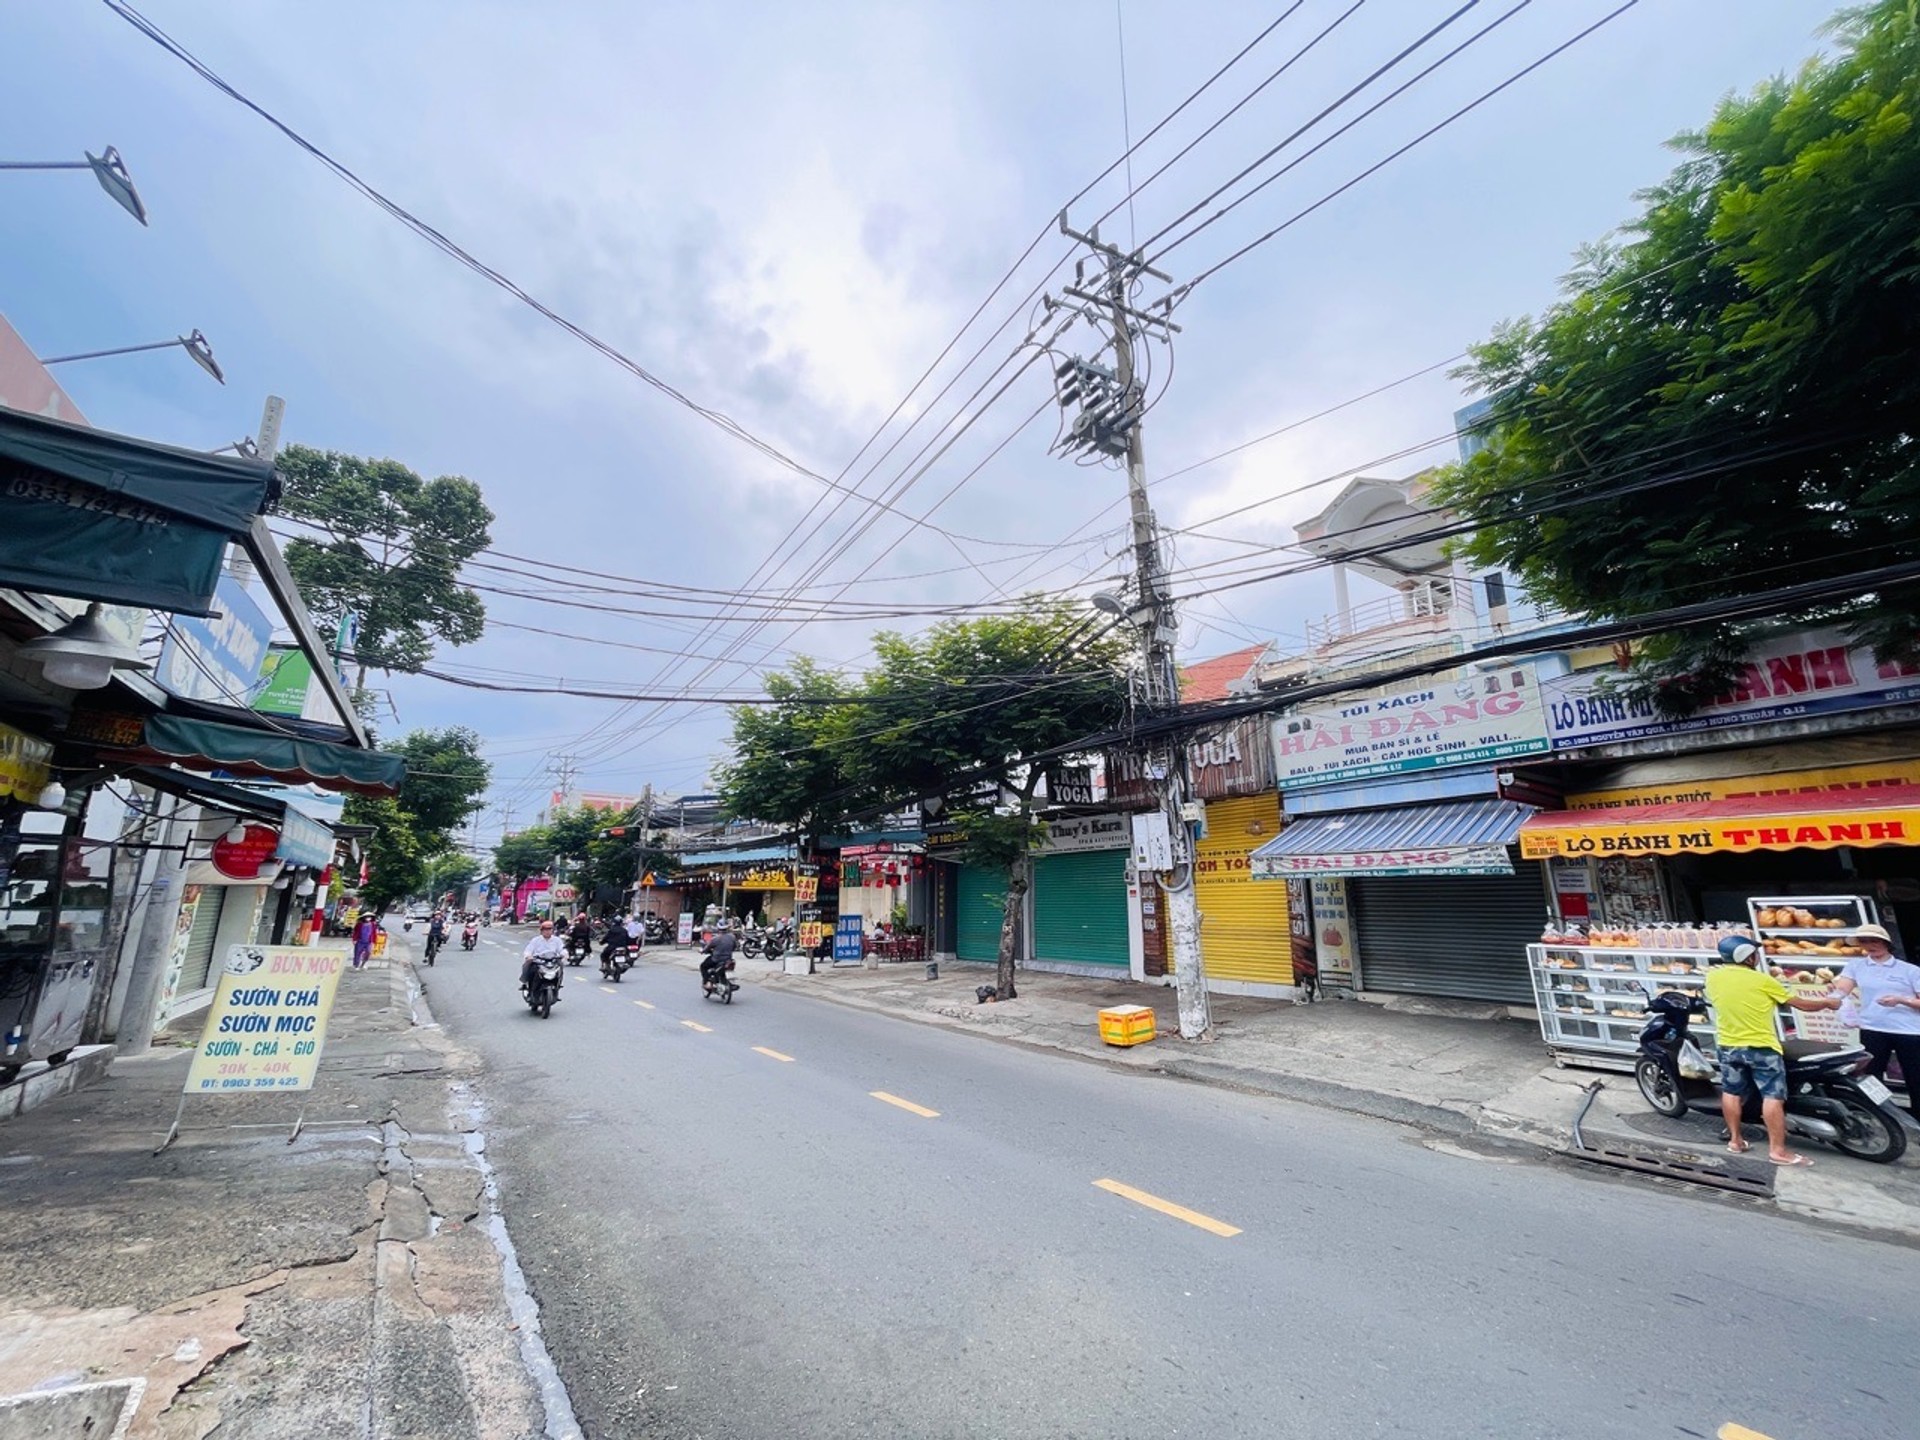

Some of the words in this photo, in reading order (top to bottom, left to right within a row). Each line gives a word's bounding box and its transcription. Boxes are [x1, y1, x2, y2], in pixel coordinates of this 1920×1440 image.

[1378, 690, 1435, 712] XÁCH
[1784, 706, 1806, 716] Q.12
[1552, 694, 1574, 731] LÒ
[1279, 723, 1355, 756] HẢI
[1368, 691, 1525, 739] ĐĂNG
[1345, 745, 1369, 756] MUA
[1414, 736, 1422, 744] &
[1436, 740, 1467, 752] SINH
[1053, 785, 1091, 803] YOGA
[1566, 835, 1596, 852] LÒ
[1601, 832, 1672, 851] BÁNH
[1677, 829, 1713, 849] MÌ
[1722, 821, 1906, 845] THANH
[270, 951, 306, 974] BÚN
[306, 955, 340, 979] MỌC
[229, 985, 281, 1006] SƯỜN
[285, 984, 321, 1006] CHẢ
[219, 1011, 272, 1033] SƯỜN
[274, 1015, 317, 1036] MỌC
[205, 1038, 243, 1056] SƯỜN
[253, 1037, 280, 1056] CHẢ
[218, 1062, 249, 1075] 30K
[262, 1062, 292, 1074] 40K
[222, 1078, 251, 1088] 0903
[278, 1077, 299, 1086] 425
